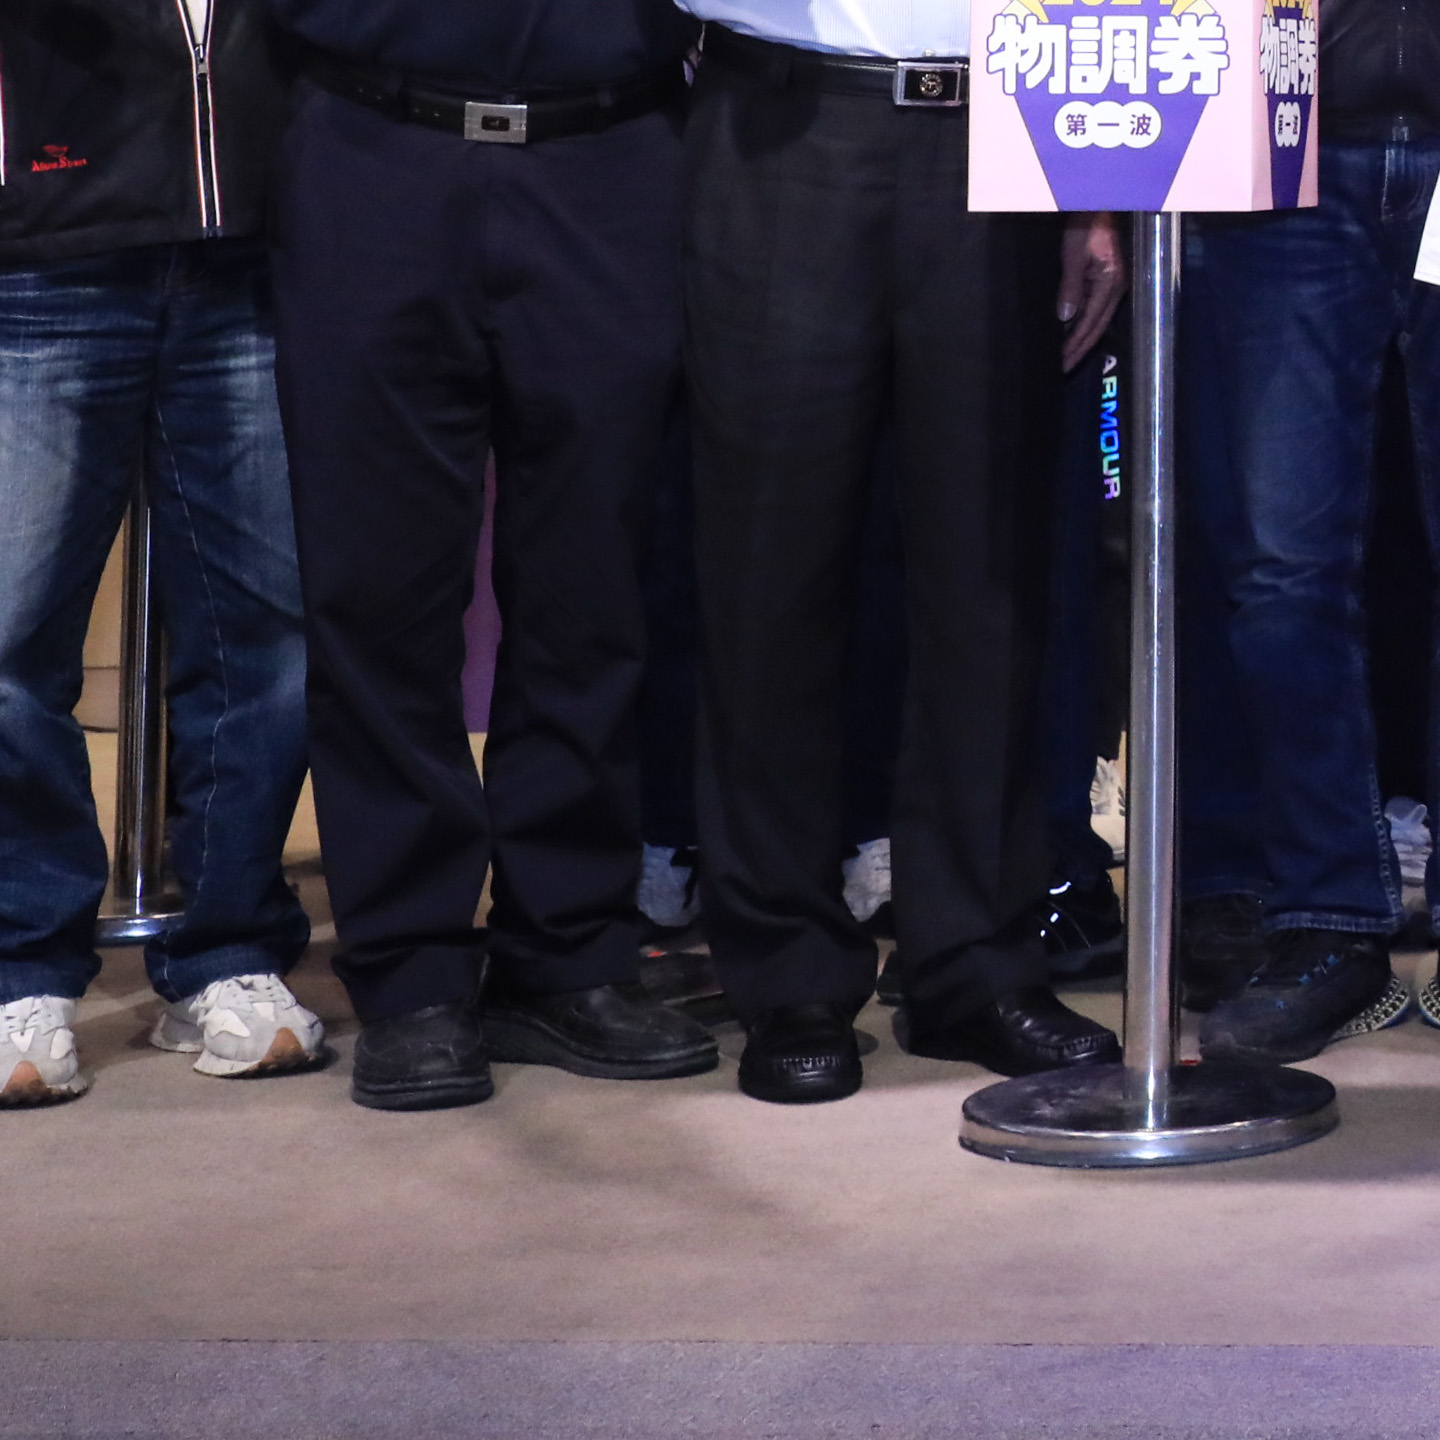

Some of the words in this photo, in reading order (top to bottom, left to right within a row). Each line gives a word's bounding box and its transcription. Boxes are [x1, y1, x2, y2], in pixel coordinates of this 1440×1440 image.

[986, 13, 1230, 96] 物調券
[1259, 14, 1317, 96] 物調券
[1066, 113, 1152, 137] 第一波
[1100, 355, 1121, 500] ARMOUR
